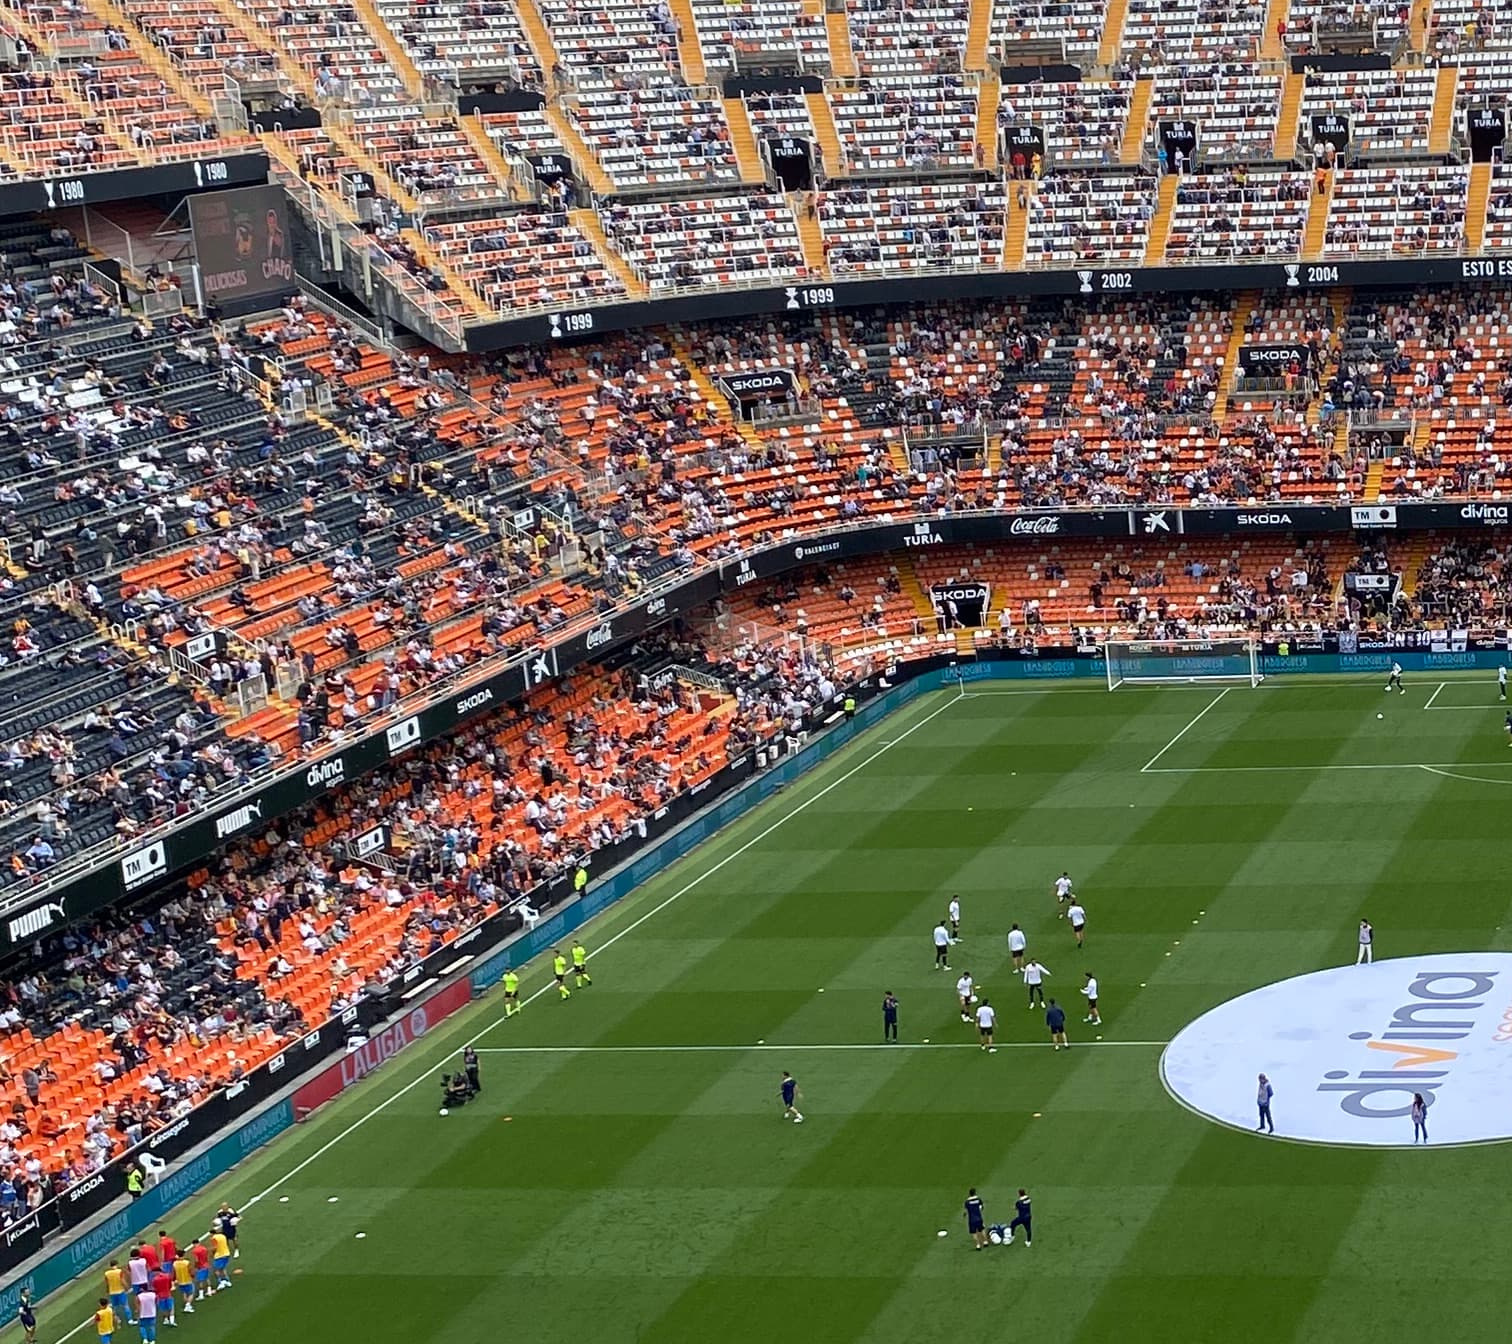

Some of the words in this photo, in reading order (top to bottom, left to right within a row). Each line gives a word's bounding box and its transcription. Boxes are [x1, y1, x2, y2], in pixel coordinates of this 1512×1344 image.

[1318, 125, 1345, 134] TURIA
[1474, 118, 1501, 127] TURIA
[1012, 136, 1040, 145] TURIA
[1166, 130, 1193, 139] TURIA
[774, 147, 803, 157] TURIA
[205, 162, 227, 181] 1980
[535, 164, 562, 175] TURIA
[59, 180, 84, 201] 1980
[1308, 266, 1338, 282] 2004
[1462, 260, 1494, 276] ESTO
[1101, 273, 1132, 289] 2002
[802, 287, 834, 306] 1999
[565, 313, 592, 331] 1999
[1249, 349, 1300, 361] SKODA
[732, 376, 783, 391] SKODA
[1354, 511, 1370, 520] TM
[1461, 504, 1508, 519] divina
[903, 533, 943, 546] TURIA
[736, 570, 757, 586] TURIA
[389, 730, 402, 746] TM
[307, 758, 344, 787] divina
[125, 860, 141, 877] TM
[9, 906, 54, 943] PUMA
[1318, 970, 1499, 1119] divina
[340, 1023, 408, 1087] LALIGA
[159, 1155, 210, 1203] LAMBURGUESA
[71, 1213, 129, 1263] LAMBURGUESA
